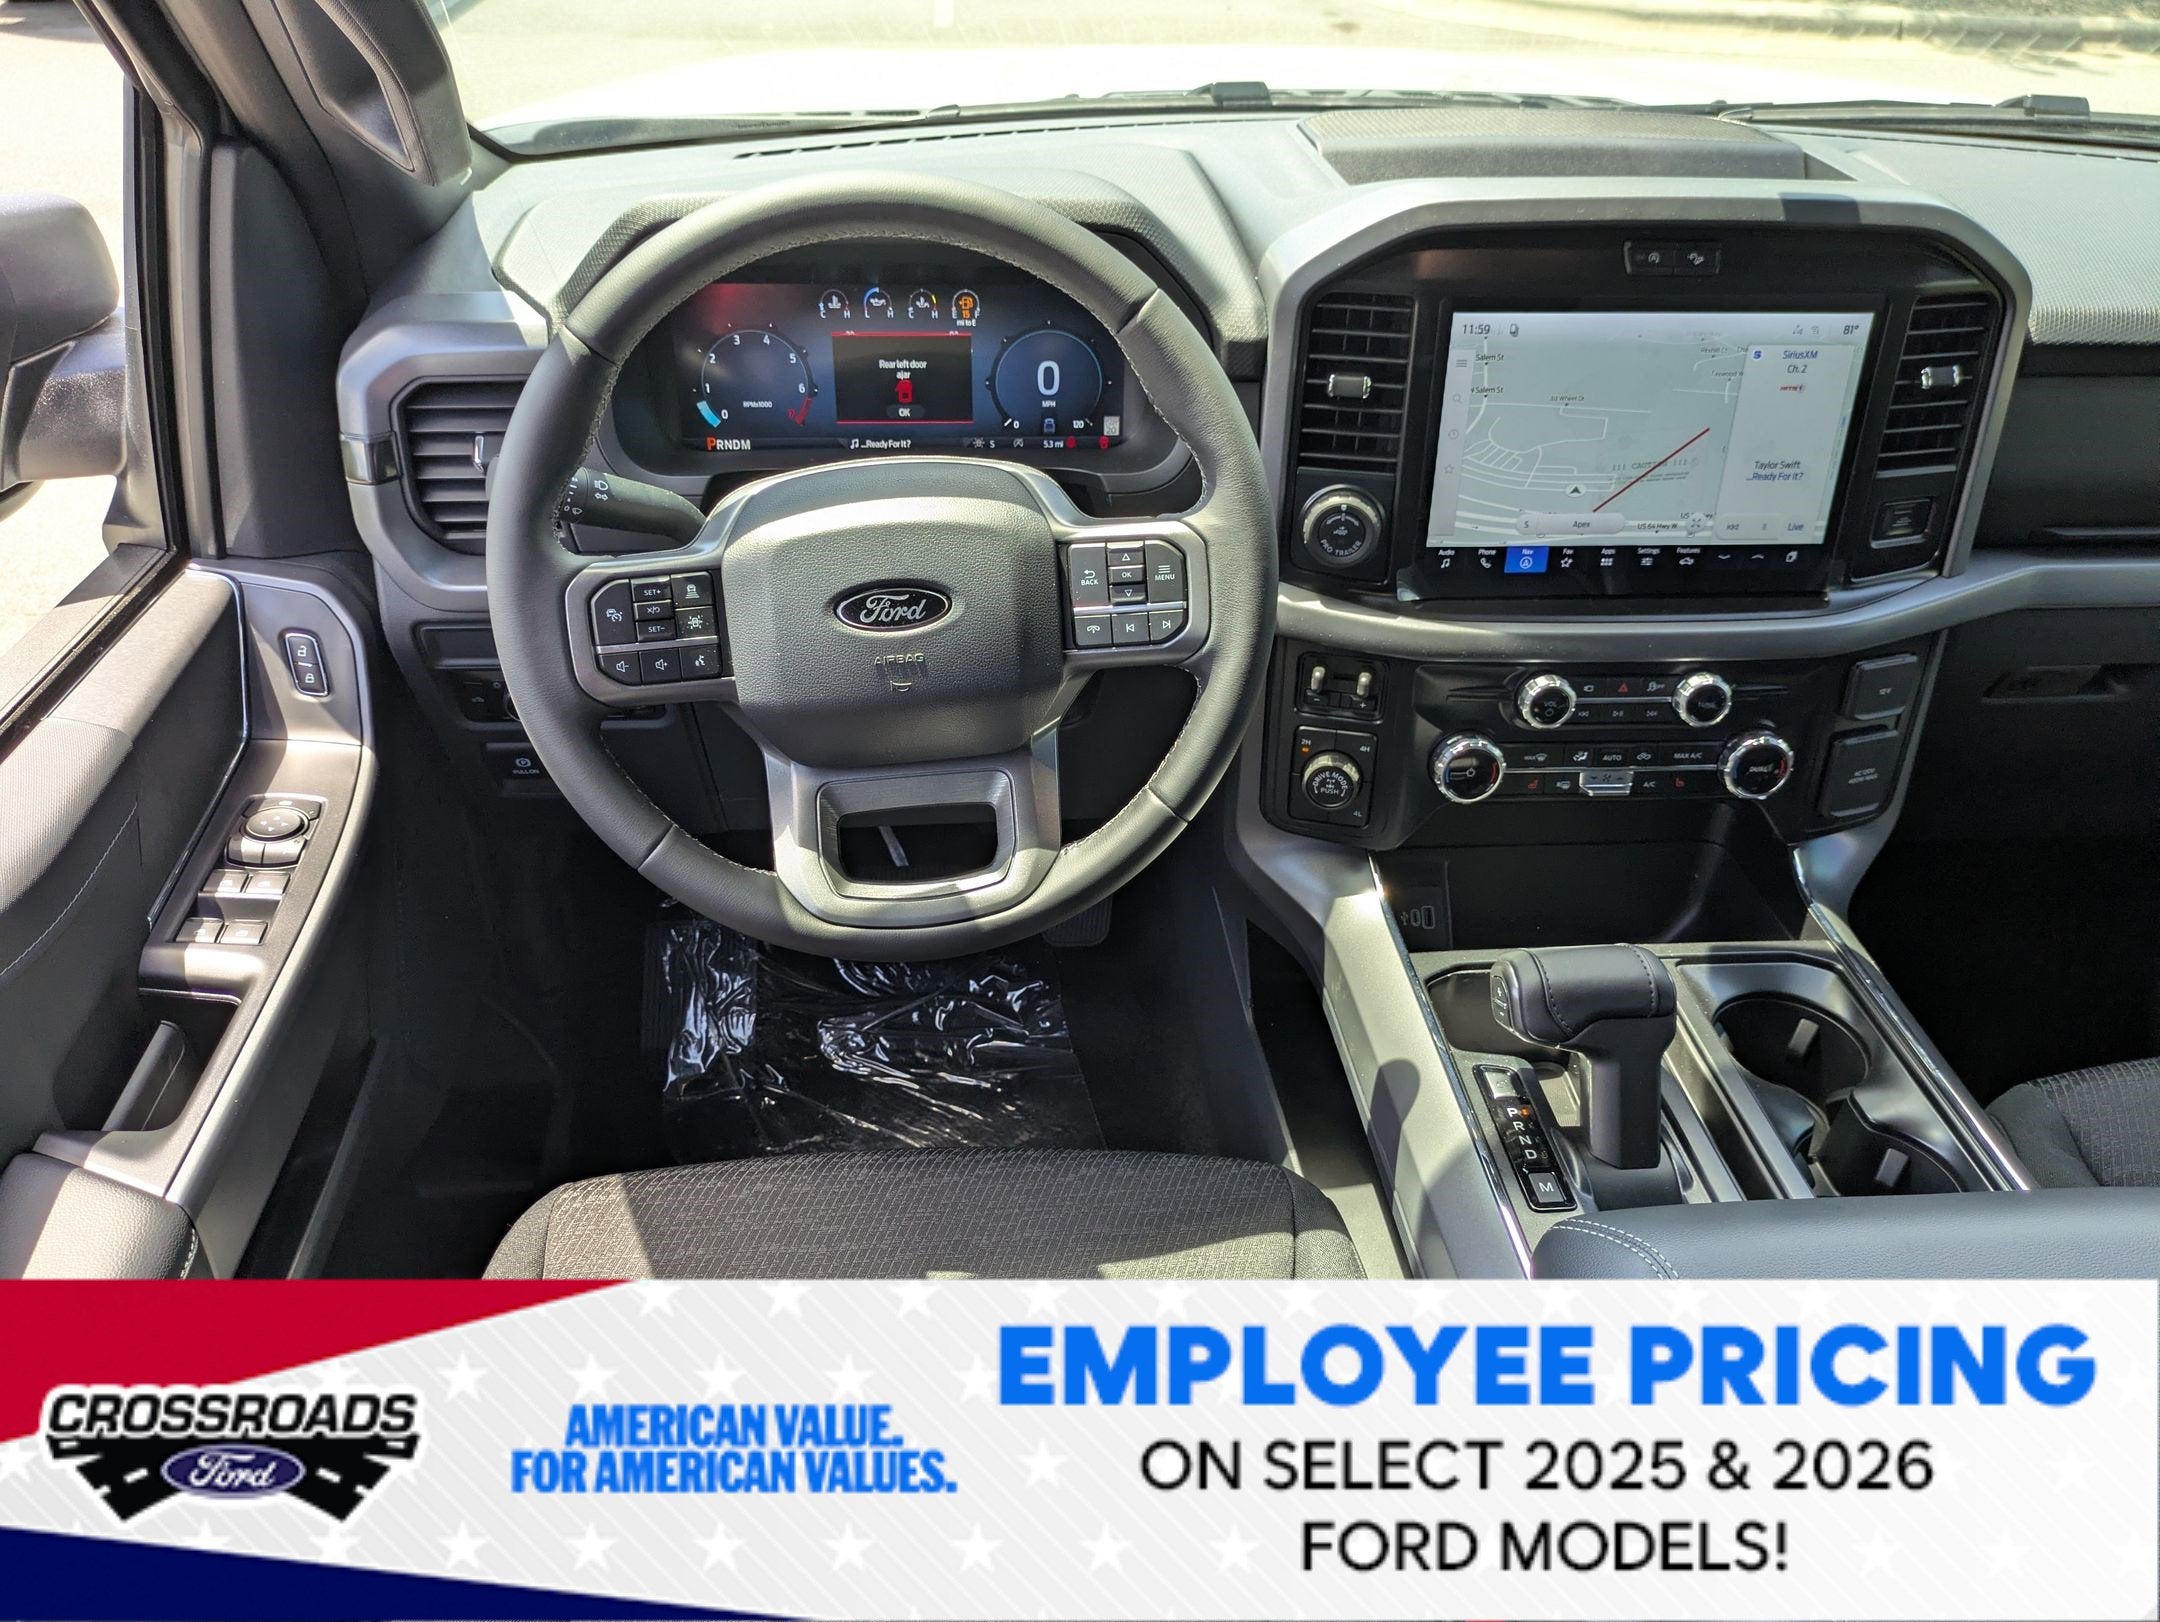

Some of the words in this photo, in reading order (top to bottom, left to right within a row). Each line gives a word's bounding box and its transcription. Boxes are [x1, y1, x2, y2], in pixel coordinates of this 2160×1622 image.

[1463, 324, 1491, 335] 11:59
[1843, 325, 1859, 335] 81°
[733, 335, 740, 346] 3
[763, 335, 770, 345] 4
[709, 353, 716, 363] 2
[789, 353, 797, 363] 5
[1782, 350, 1818, 359] SiriusXM
[879, 359, 897, 369] Rear
[897, 359, 910, 369] left
[910, 359, 928, 369] door
[1787, 364, 1801, 373] Ch.
[896, 371, 911, 380] ajar
[1037, 360, 1060, 396] 0
[798, 383, 806, 394] 6
[721, 410, 729, 419] 0
[898, 407, 911, 417] OK
[1013, 420, 1020, 429] 0
[1073, 420, 1085, 429] 120
[889, 440, 900, 448] For
[901, 440, 911, 448] It?
[1754, 461, 1778, 470] Taylor
[1780, 461, 1800, 469] Swift
[1778, 472, 1790, 480] For
[1572, 520, 1590, 529] Apex
[1787, 523, 1804, 531] Live
[1320, 539, 1333, 553] PRO
[1335, 540, 1362, 556] TRAILER
[1601, 548, 1616, 556] Apps
[1637, 547, 1660, 556] Settings
[1155, 573, 1176, 581] MENU
[1081, 578, 1099, 586] BACK
[860, 595, 927, 622] Ford
[874, 653, 925, 664] AIRBAG
[1602, 754, 1622, 762] AUTO
[1690, 752, 1702, 760] A/C
[1312, 771, 1330, 787] DRIVE
[1331, 771, 1348, 790] MODE
[1643, 780, 1656, 788] A/C
[1320, 787, 1339, 795] PUSH
[1507, 1107, 1518, 1118] P
[1513, 1121, 1525, 1131] R
[1518, 1135, 1532, 1146] N
[1524, 1150, 1537, 1160] D
[1538, 1182, 1554, 1193] M
